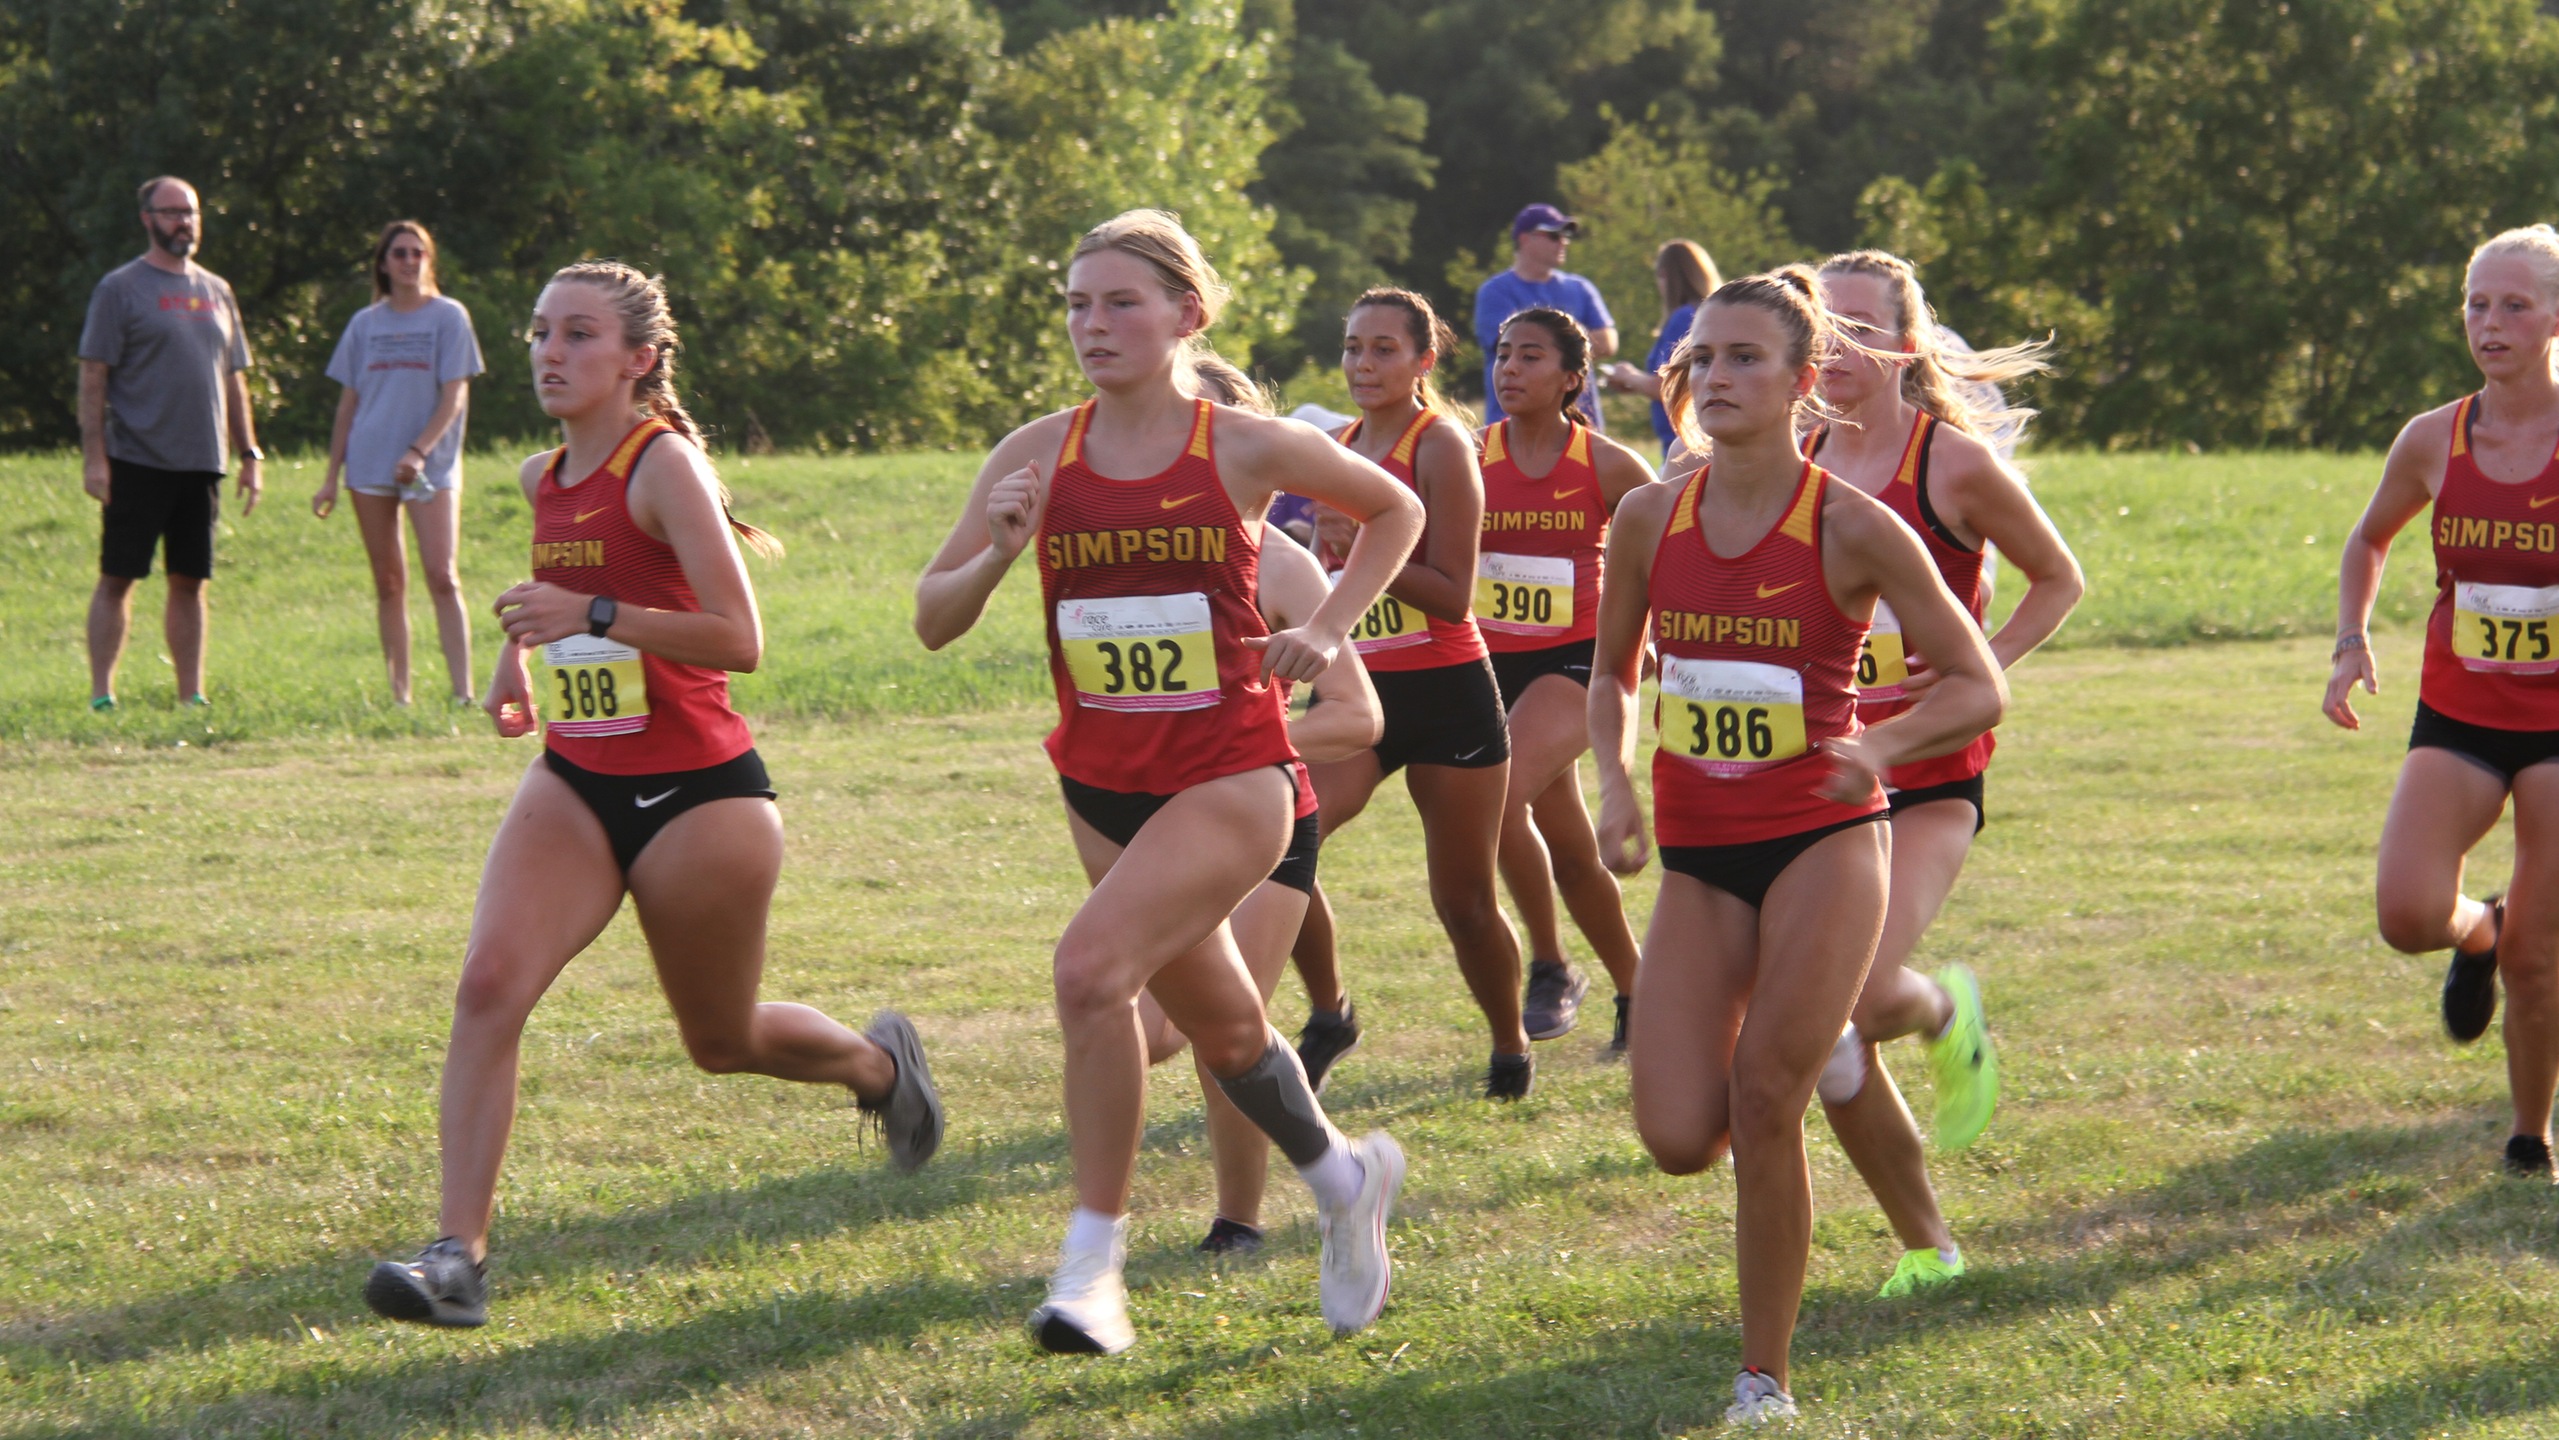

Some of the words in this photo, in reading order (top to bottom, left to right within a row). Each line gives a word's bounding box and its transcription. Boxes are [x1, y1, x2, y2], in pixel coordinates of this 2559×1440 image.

[1482, 510, 1585, 532] SIMPSON
[2438, 516, 2556, 553] SIMPSO
[1048, 526, 1227, 570] SIMPSON
[1493, 583, 1551, 624] 390
[1660, 610, 1801, 648] SIMPSON
[2479, 617, 2551, 660] 375
[1097, 639, 1188, 694] 382
[555, 667, 618, 719] 388
[1687, 702, 1773, 758] 386
